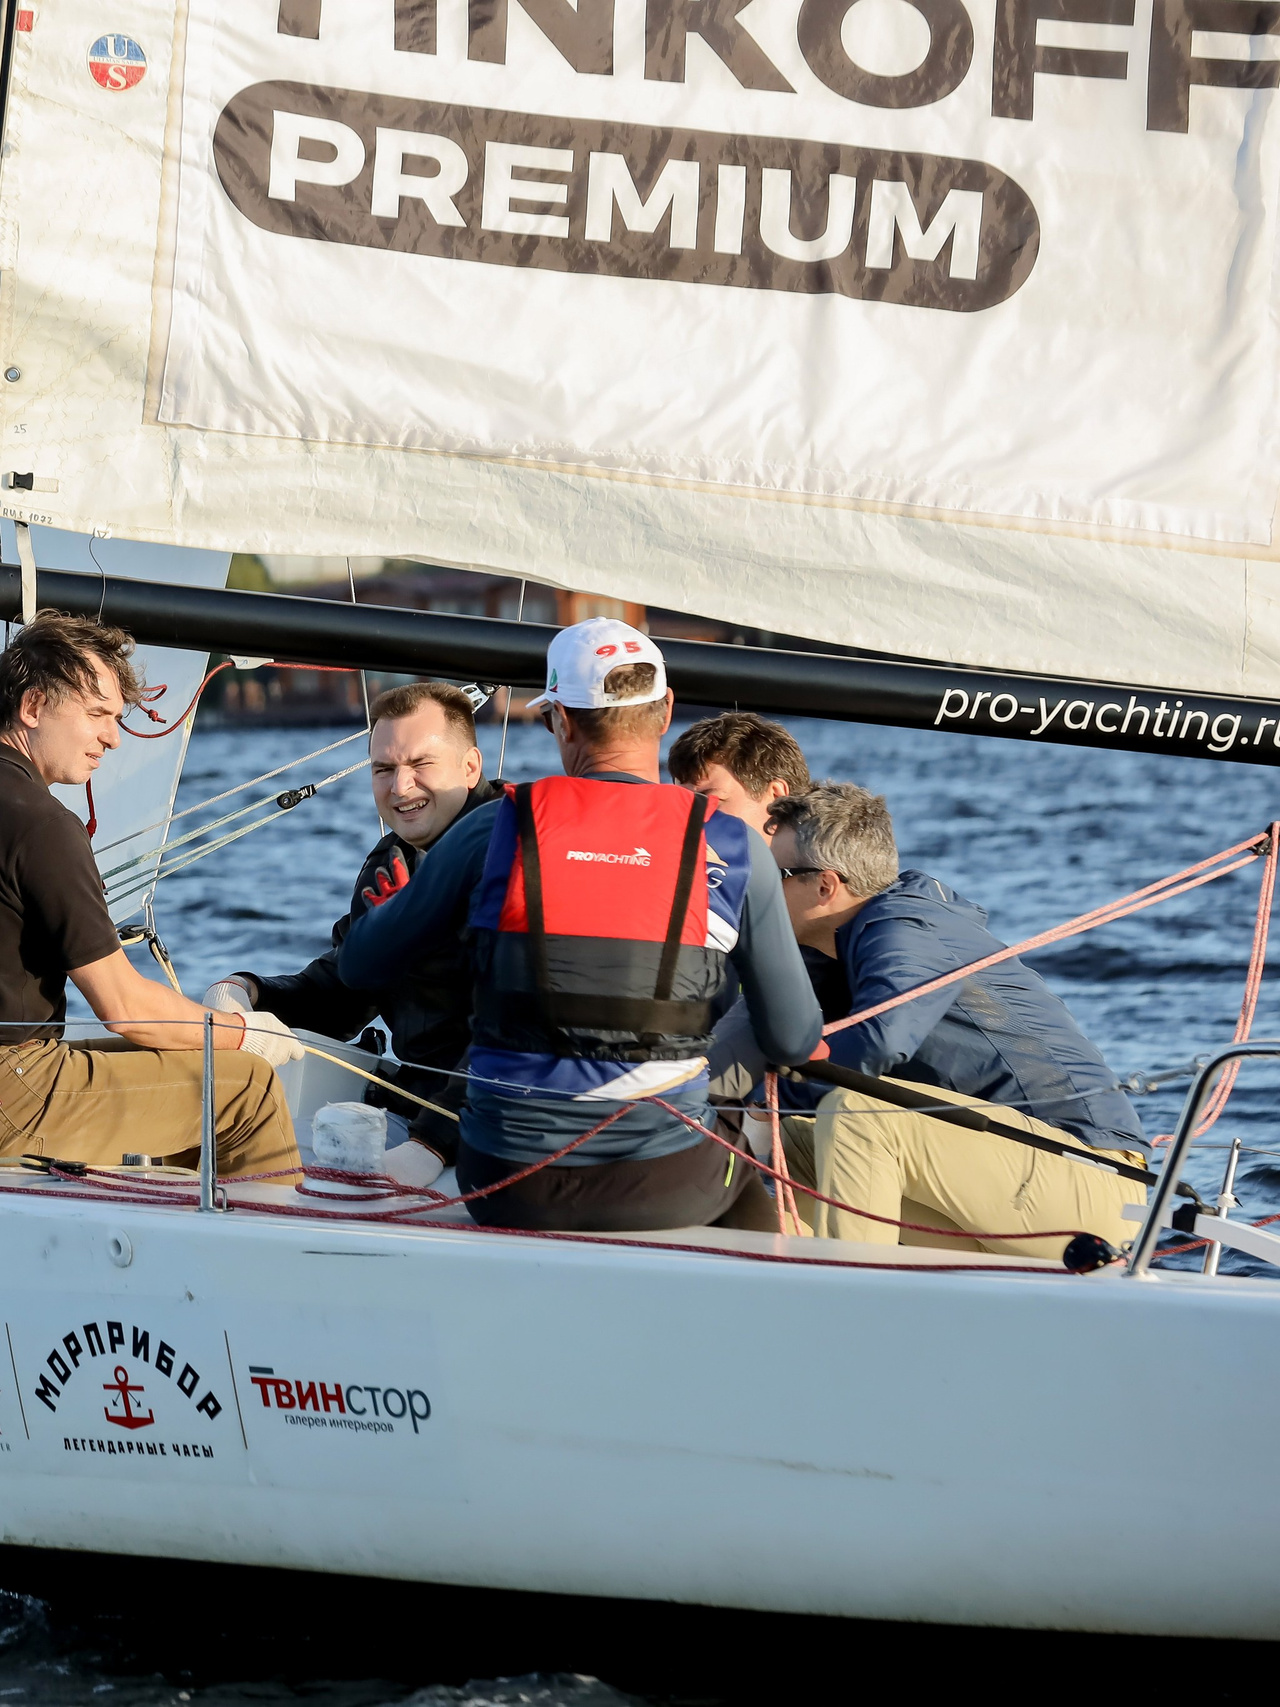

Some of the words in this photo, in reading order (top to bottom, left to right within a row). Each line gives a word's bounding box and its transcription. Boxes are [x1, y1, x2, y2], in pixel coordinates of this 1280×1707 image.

[106, 36, 128, 58] U
[106, 65, 127, 90] S
[278, 0, 1280, 134] NKOFF
[268, 111, 982, 281] PREMIUM
[13, 423, 28, 434] 25
[566, 850, 651, 867] PROYACHTING
[35, 1321, 223, 1421] МОРПРИБОР
[285, 1414, 327, 1429] галерея
[330, 1417, 394, 1434] интерьеров
[64, 1437, 167, 1456] ЛЕГЕНДАРНЫЕ
[172, 1443, 214, 1458] ЧАСЫ
